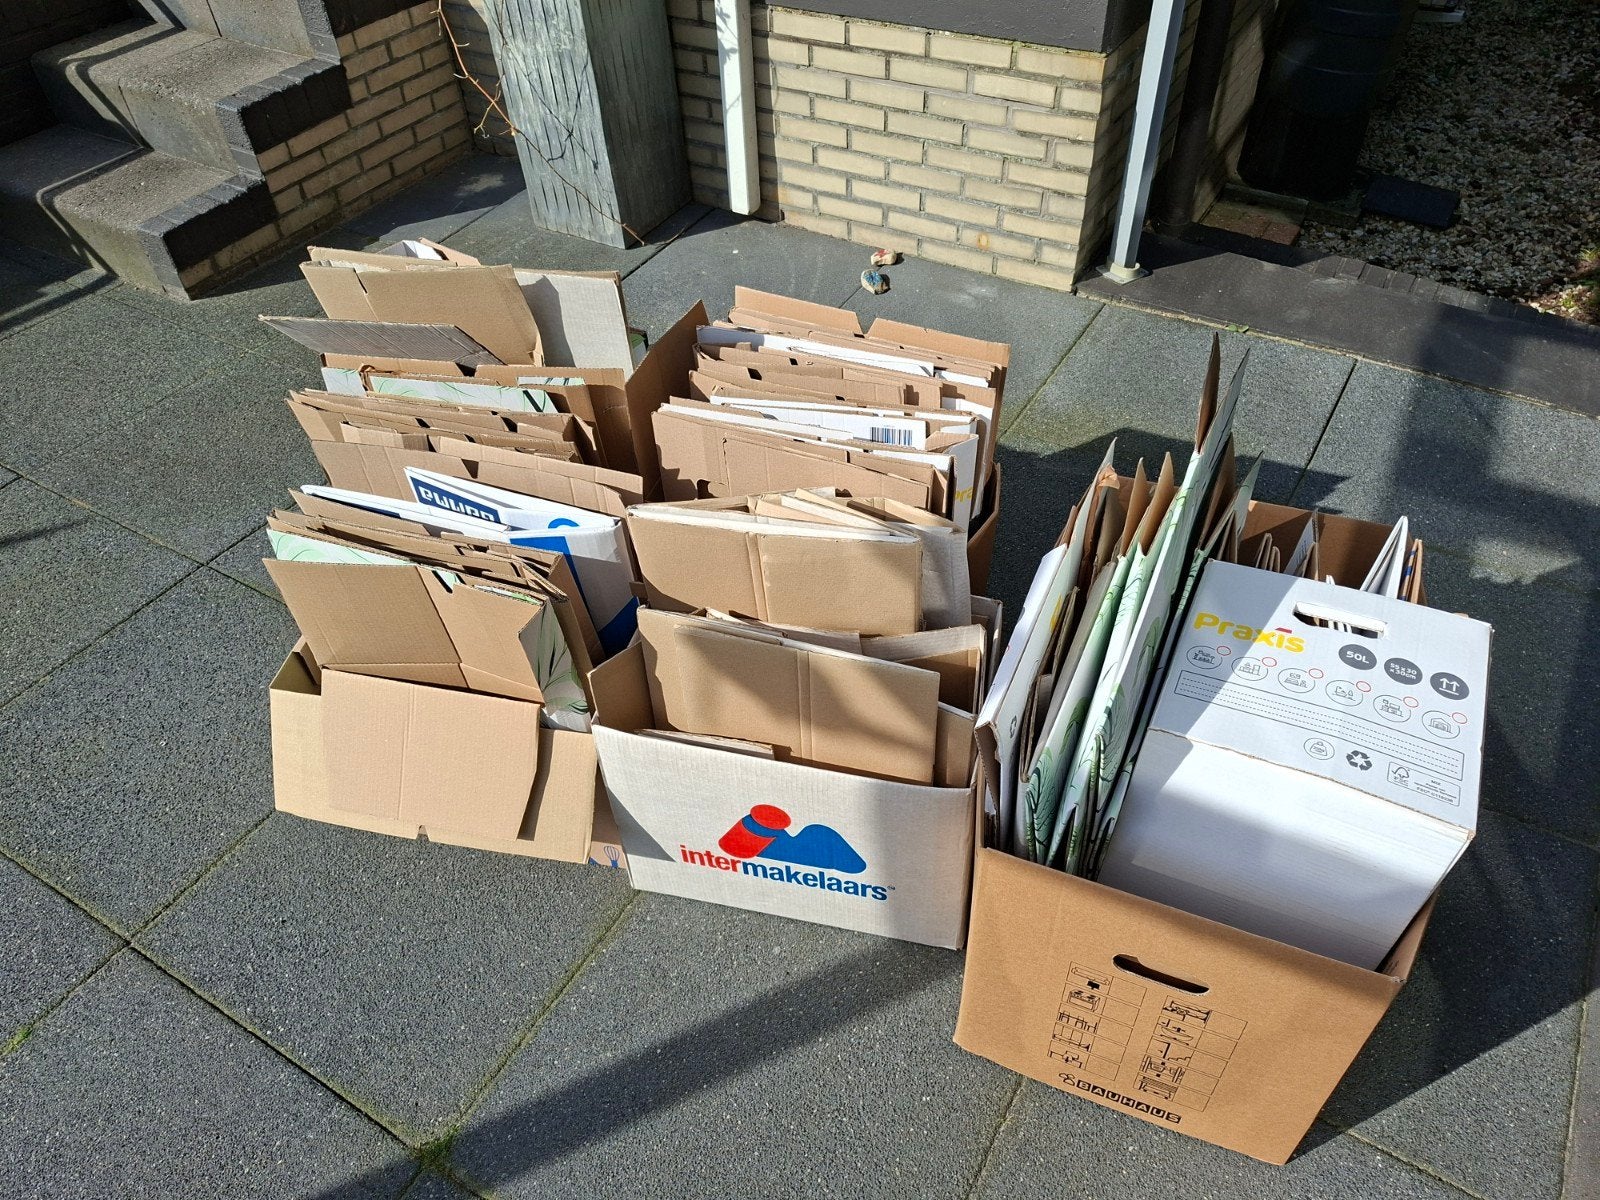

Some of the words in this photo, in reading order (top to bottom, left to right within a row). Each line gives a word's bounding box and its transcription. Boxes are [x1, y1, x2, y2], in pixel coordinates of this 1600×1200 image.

[1193, 612, 1305, 653] Praxis
[1346, 650, 1370, 664] 50L
[1076, 1079, 1182, 1124] BAUHAUS
